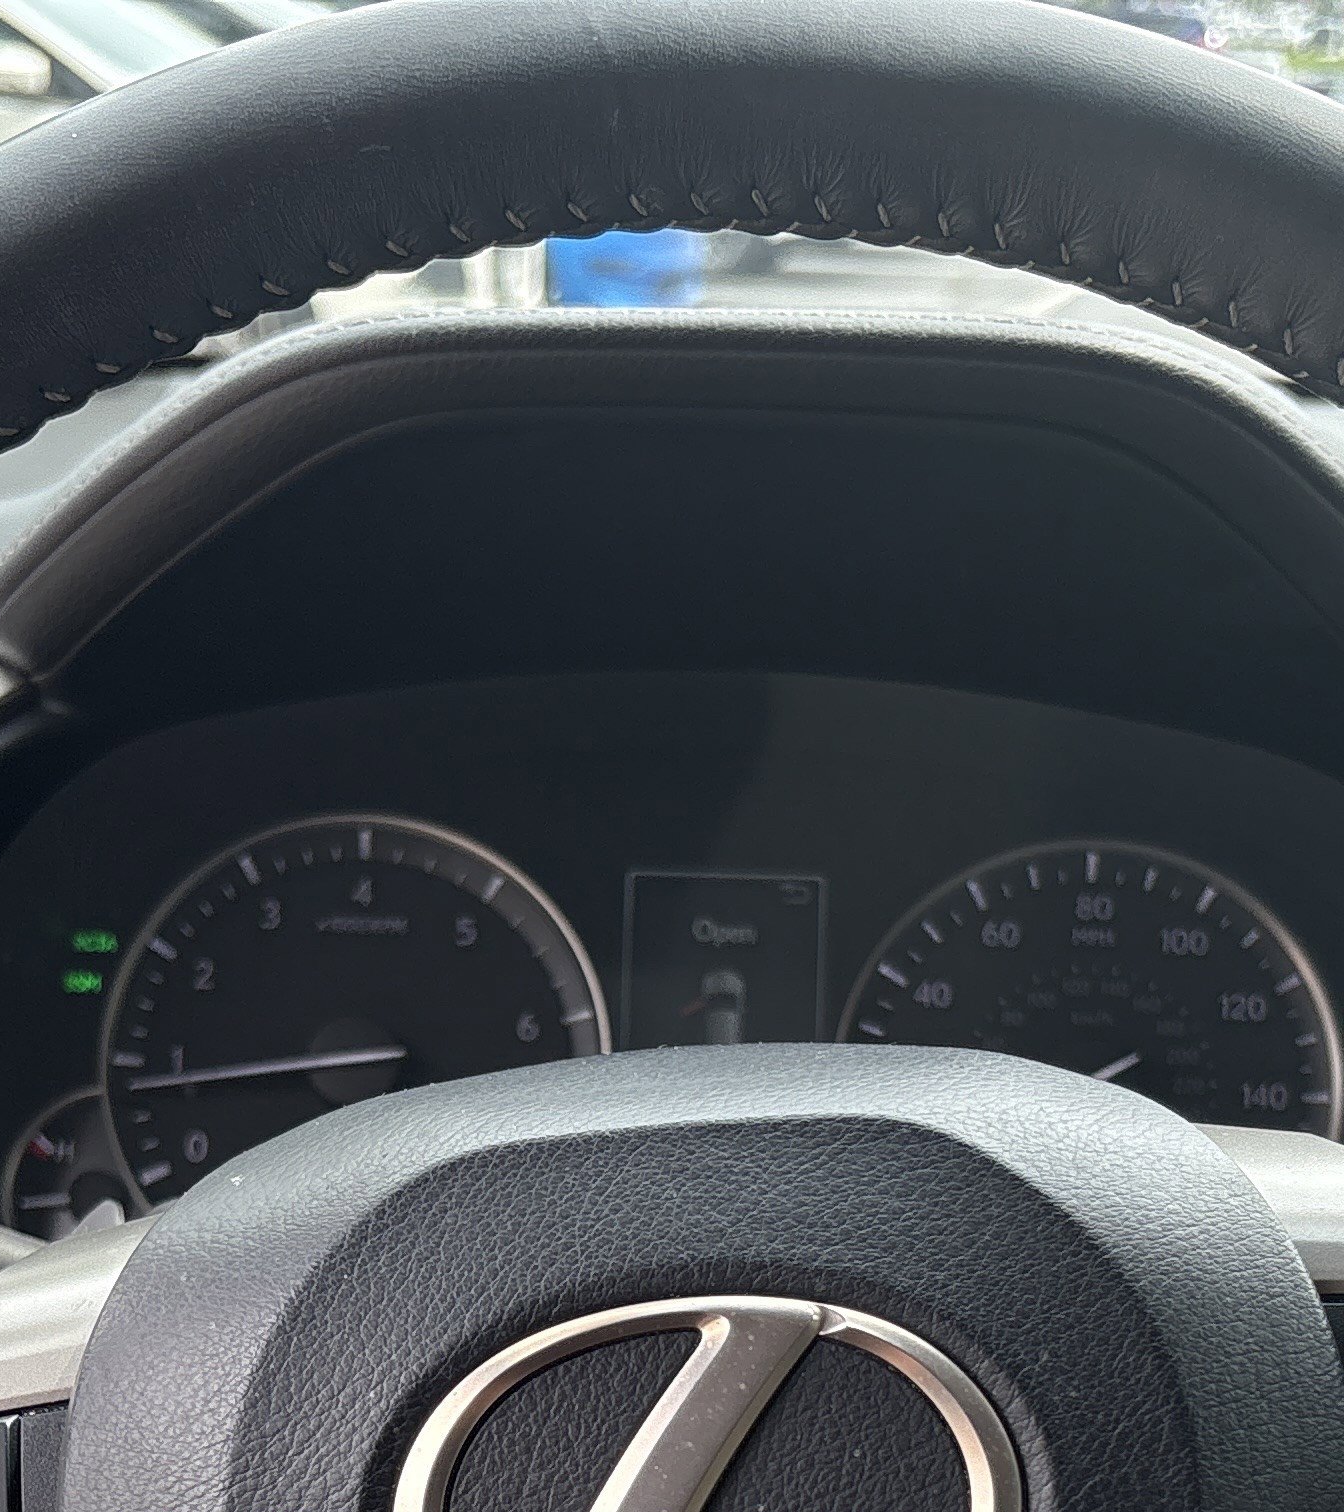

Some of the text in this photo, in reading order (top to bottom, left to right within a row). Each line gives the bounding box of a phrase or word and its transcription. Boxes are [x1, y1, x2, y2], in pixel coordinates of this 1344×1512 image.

[259, 898, 282, 931] 3
[1075, 894, 1115, 922] 80
[455, 915, 479, 947] 5
[980, 920, 1022, 949] 60
[1160, 929, 1211, 957] 100
[192, 956, 216, 991] 2
[912, 981, 954, 1009] 40
[1219, 994, 1268, 1022] 120
[516, 1010, 541, 1043] 6
[183, 1128, 210, 1164] 0
